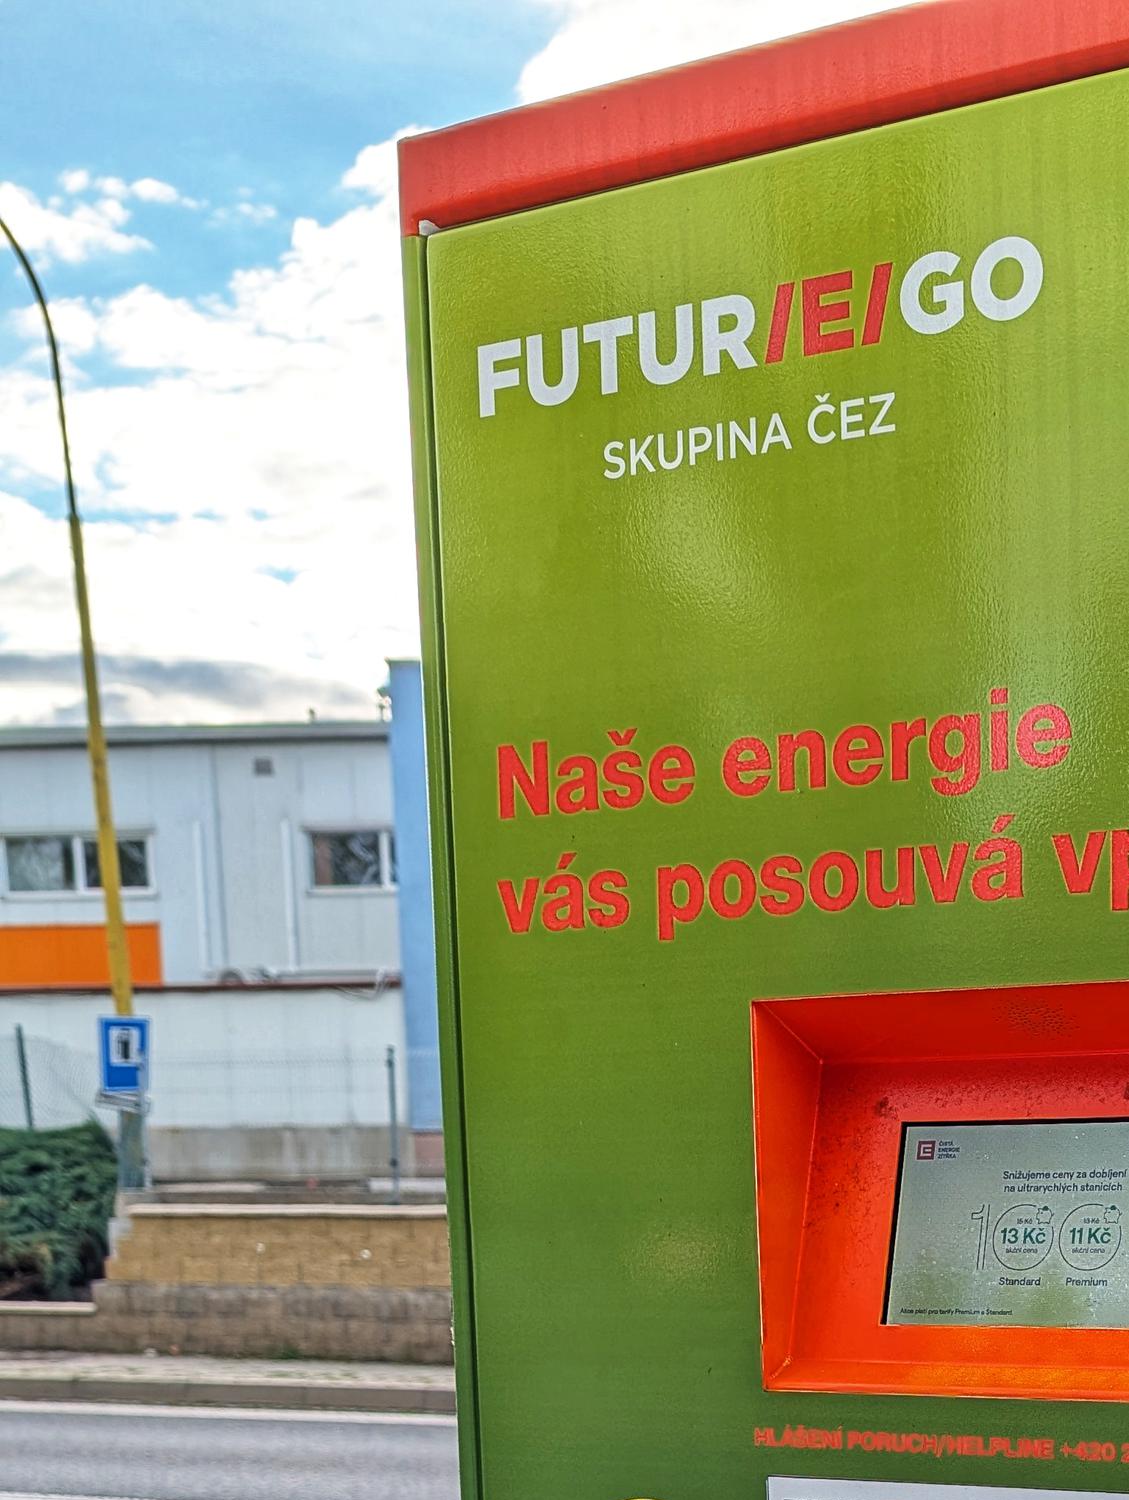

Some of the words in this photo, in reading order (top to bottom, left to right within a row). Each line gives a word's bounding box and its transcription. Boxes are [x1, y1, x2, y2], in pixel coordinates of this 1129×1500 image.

[477, 236, 1044, 418] FUTUR/E/GO
[603, 412, 792, 480] SKUPINA
[807, 391, 896, 444] ČEZ
[497, 727, 696, 820] Naše
[722, 688, 1073, 797] energie
[497, 852, 630, 935] vás
[657, 814, 1024, 942] posouvá
[1003, 1169, 1050, 1181] Snižujeme
[1052, 1172, 1073, 1181] ceny
[1089, 1169, 1127, 1180] dobíjení
[1004, 1185, 1015, 1193] na
[1017, 1183, 1078, 1194] ultrarychlých
[1080, 1183, 1122, 1192] stanicích
[1001, 1228, 1019, 1244] 13
[1023, 1227, 1046, 1245] Kč
[1070, 1228, 1082, 1244] 11
[1087, 1227, 1111, 1244] Kč
[999, 1277, 1041, 1286] Standard
[1066, 1277, 1108, 1287] Premium
[754, 1424, 843, 1449] HLÁŠENÍ
[1060, 1441, 1116, 1462] +420
